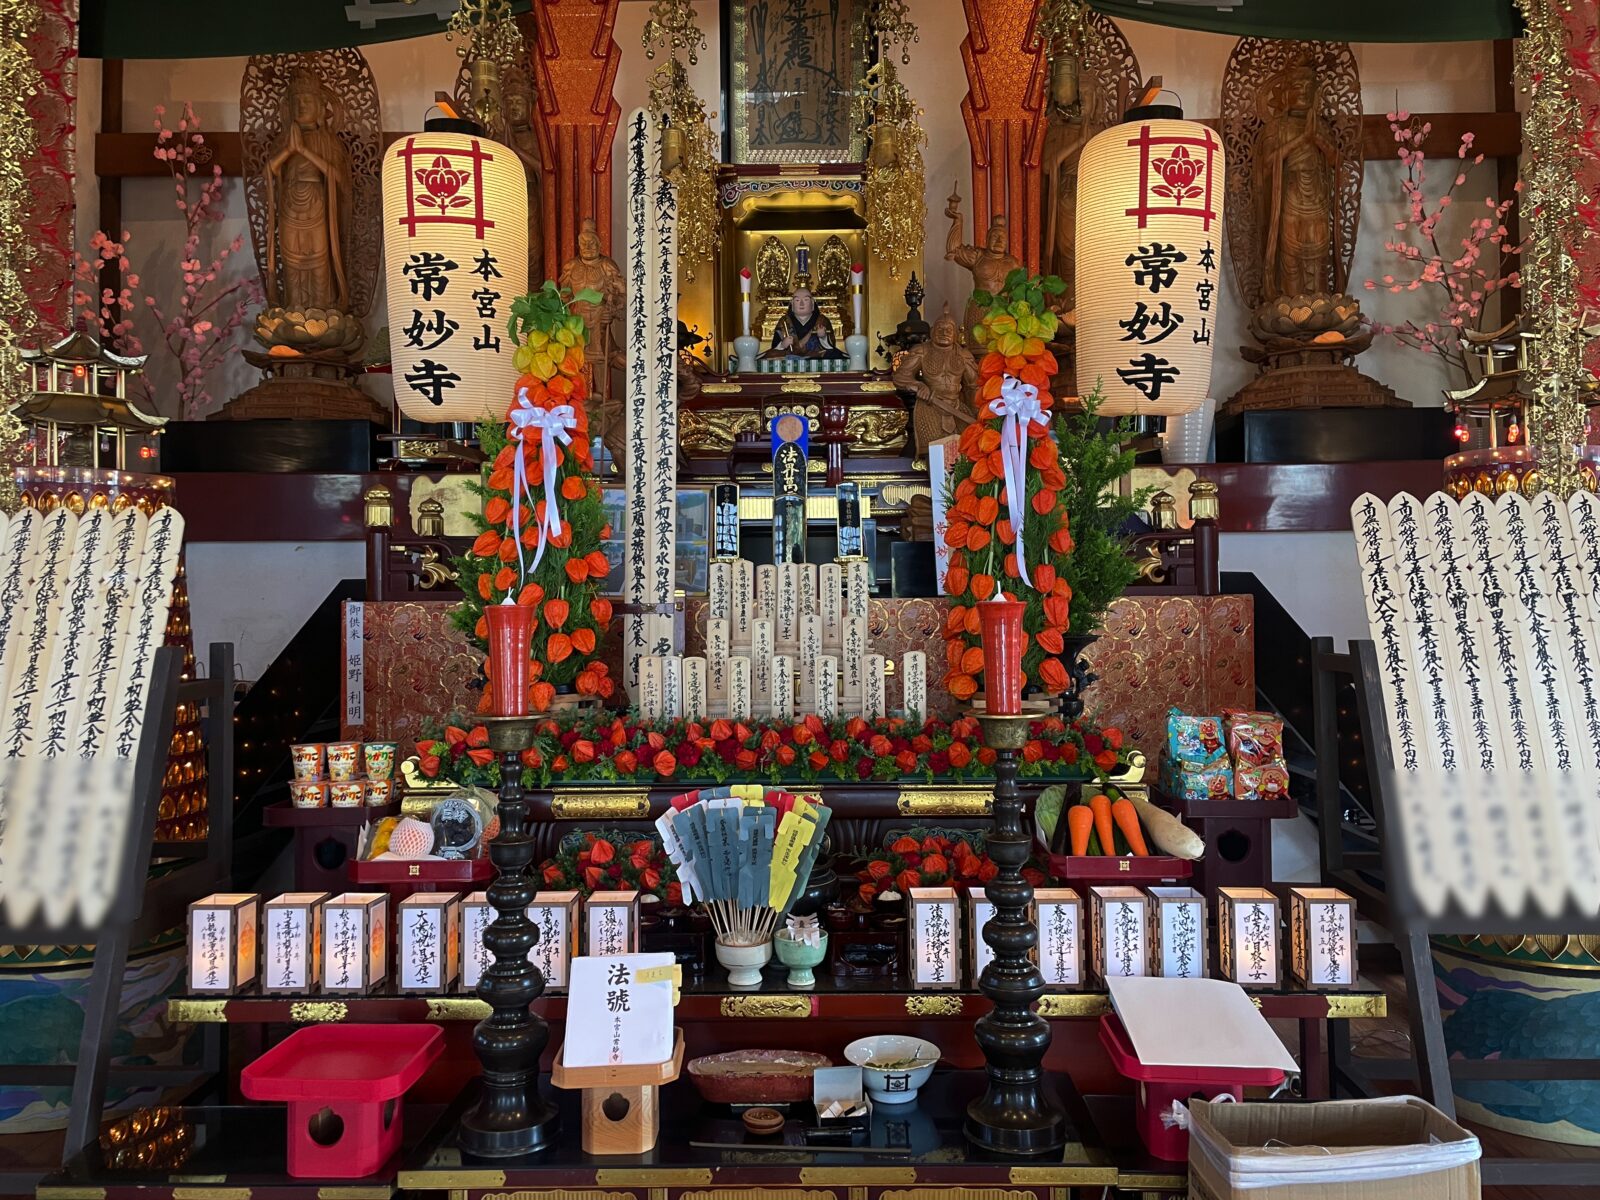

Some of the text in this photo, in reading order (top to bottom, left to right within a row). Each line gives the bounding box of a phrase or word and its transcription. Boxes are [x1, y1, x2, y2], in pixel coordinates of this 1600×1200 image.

[403, 252, 462, 406] 常妙寺
[468, 248, 503, 353] 本宮山
[1116, 241, 1188, 402] 常妙寺
[1193, 240, 1215, 346] 本宮山
[348, 604, 362, 720] 御供米 姫野 利明
[607, 963, 631, 1013] 法號
